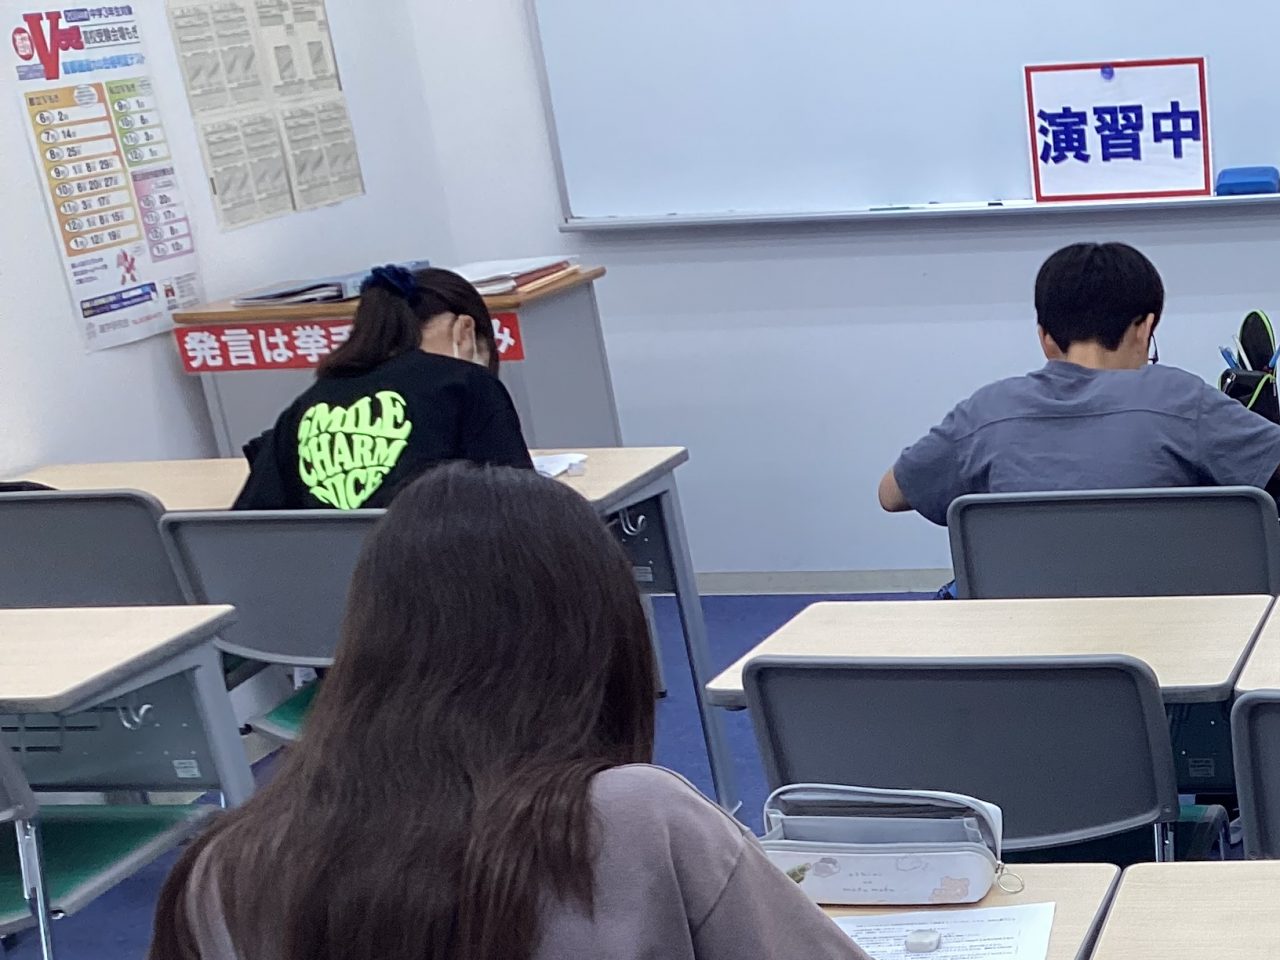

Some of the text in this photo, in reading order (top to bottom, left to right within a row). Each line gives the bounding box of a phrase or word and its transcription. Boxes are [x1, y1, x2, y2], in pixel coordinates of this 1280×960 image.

[1037, 101, 1201, 165] 演習中
[298, 391, 412, 441] SMILE
[298, 431, 408, 488] CHARM
